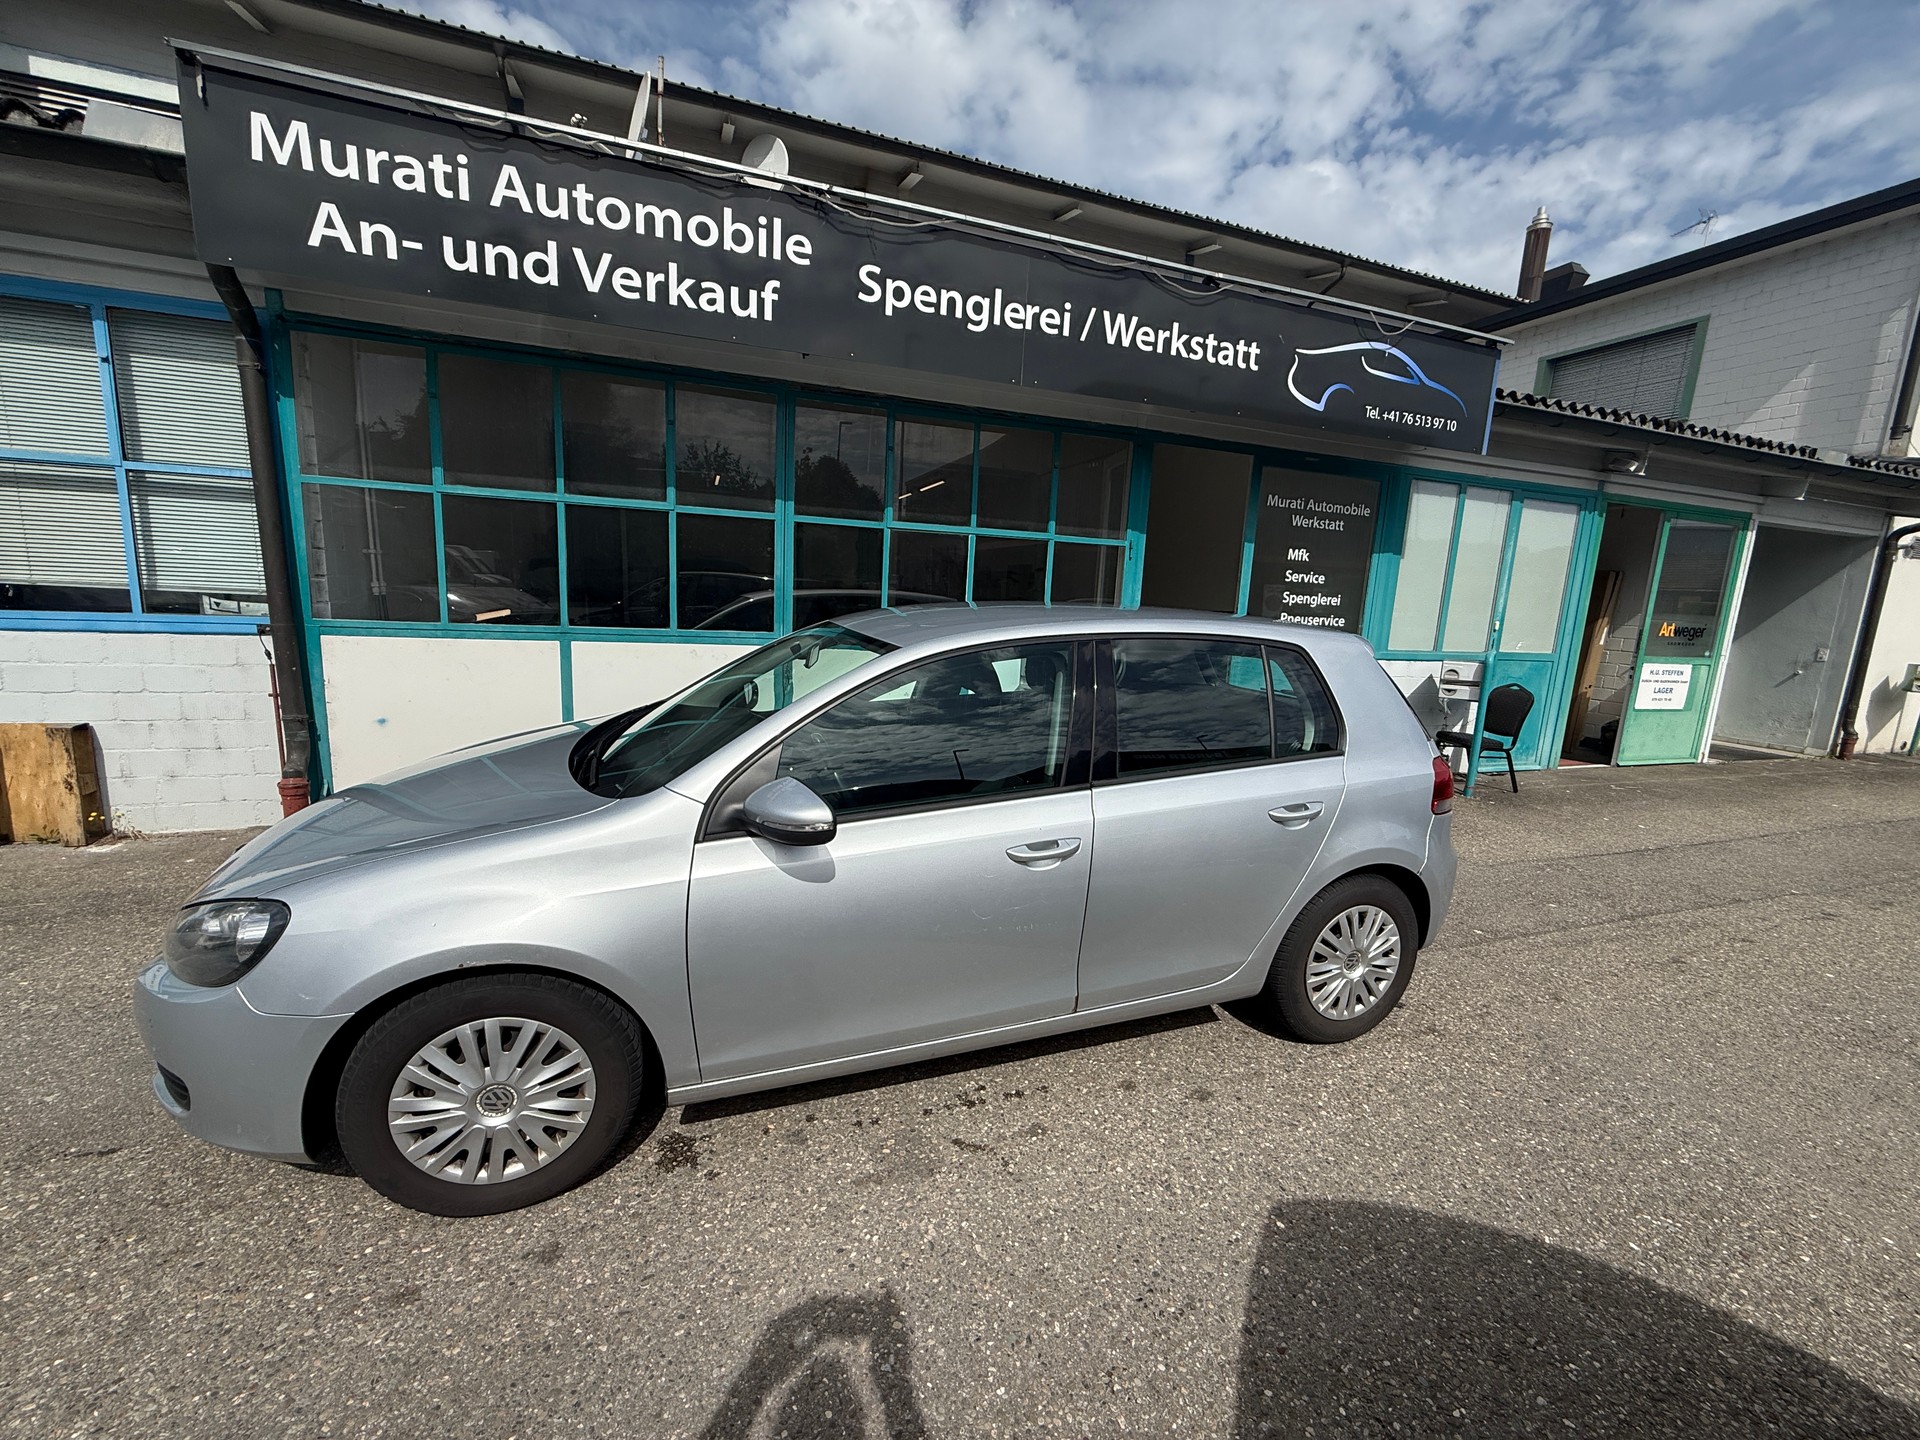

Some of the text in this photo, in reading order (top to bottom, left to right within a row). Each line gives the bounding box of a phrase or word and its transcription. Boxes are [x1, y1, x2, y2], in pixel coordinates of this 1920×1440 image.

[250, 111, 813, 266] Murati Automobile
[307, 201, 782, 321] An- und Verkauf
[857, 264, 1261, 372] Spenglerei / Werkstatt
[1365, 405, 1457, 432] Tel. +41 76 513 97 10
[1266, 494, 1371, 517] Murati Automobile
[1291, 514, 1345, 532] Werkstatt
[1287, 548, 1310, 562] Mfk
[1284, 569, 1326, 585] Service
[1282, 591, 1342, 608] Spenglerei
[1280, 612, 1346, 627] Pneuservice
[1658, 621, 1707, 641] Artweger
